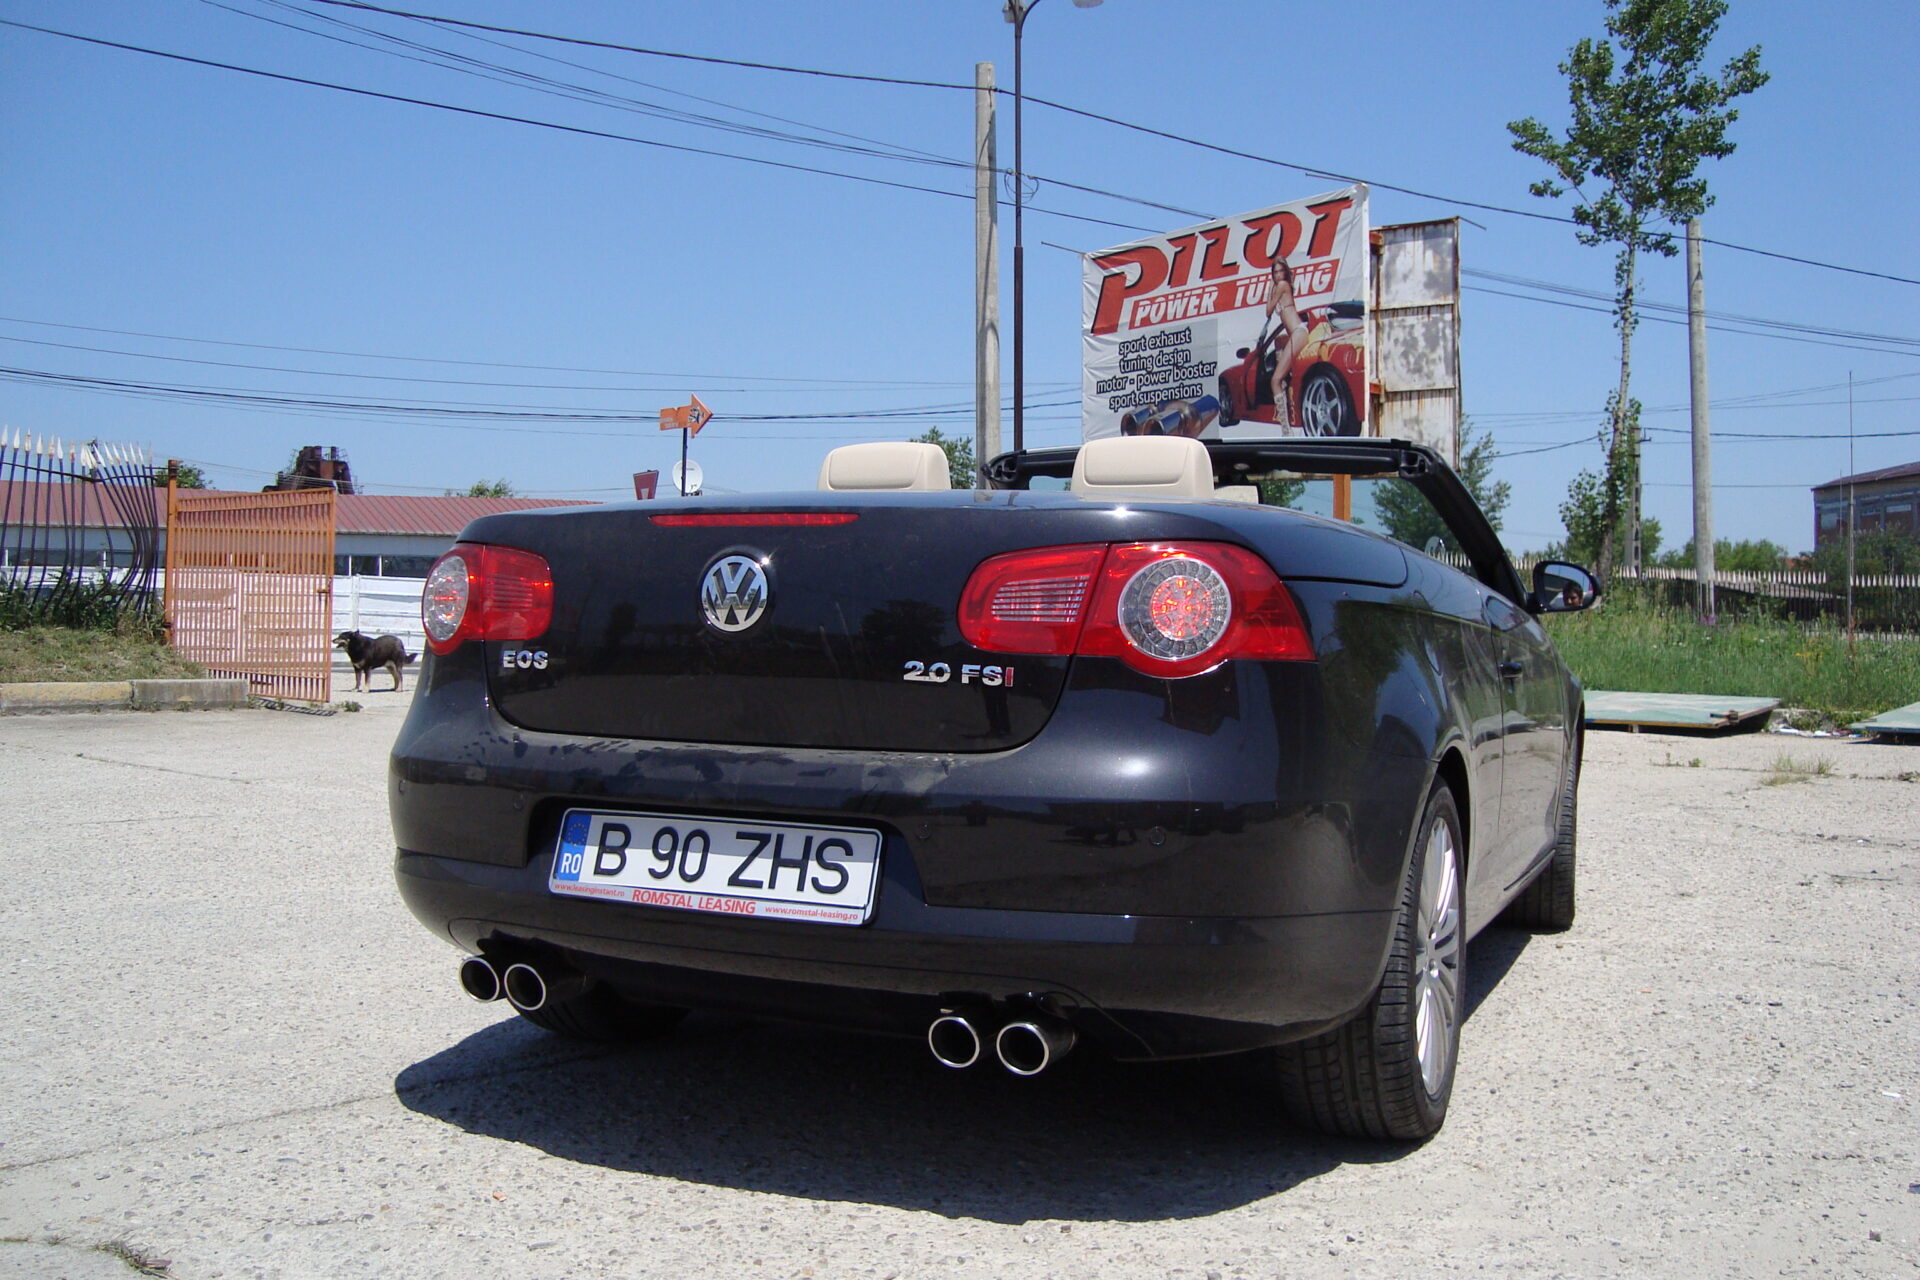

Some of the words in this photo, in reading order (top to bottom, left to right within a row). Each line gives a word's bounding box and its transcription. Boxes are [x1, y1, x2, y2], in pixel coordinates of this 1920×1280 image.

[1090, 196, 1353, 336] PILOT
[1134, 286, 1219, 327] POWER
[1234, 262, 1333, 307] TUNG
[1119, 334, 1147, 357] sport
[1147, 326, 1191, 350] exhaust
[1120, 355, 1153, 374] tuning
[1155, 348, 1191, 368] design
[1097, 375, 1128, 394] motor
[1136, 368, 1172, 390] power
[1173, 361, 1217, 380] booster
[1109, 390, 1138, 412] sport
[1138, 383, 1203, 407] suspensions
[503, 650, 549, 669] EOS
[961, 664, 1015, 687] FSI
[560, 852, 583, 875] RO
[593, 822, 632, 877] B
[647, 826, 711, 884] 90
[727, 831, 854, 895] ZHS
[632, 889, 693, 908] ROMSTAL
[697, 896, 757, 915] LEASING
[765, 905, 859, 921] www.romstal-leasing.ro
